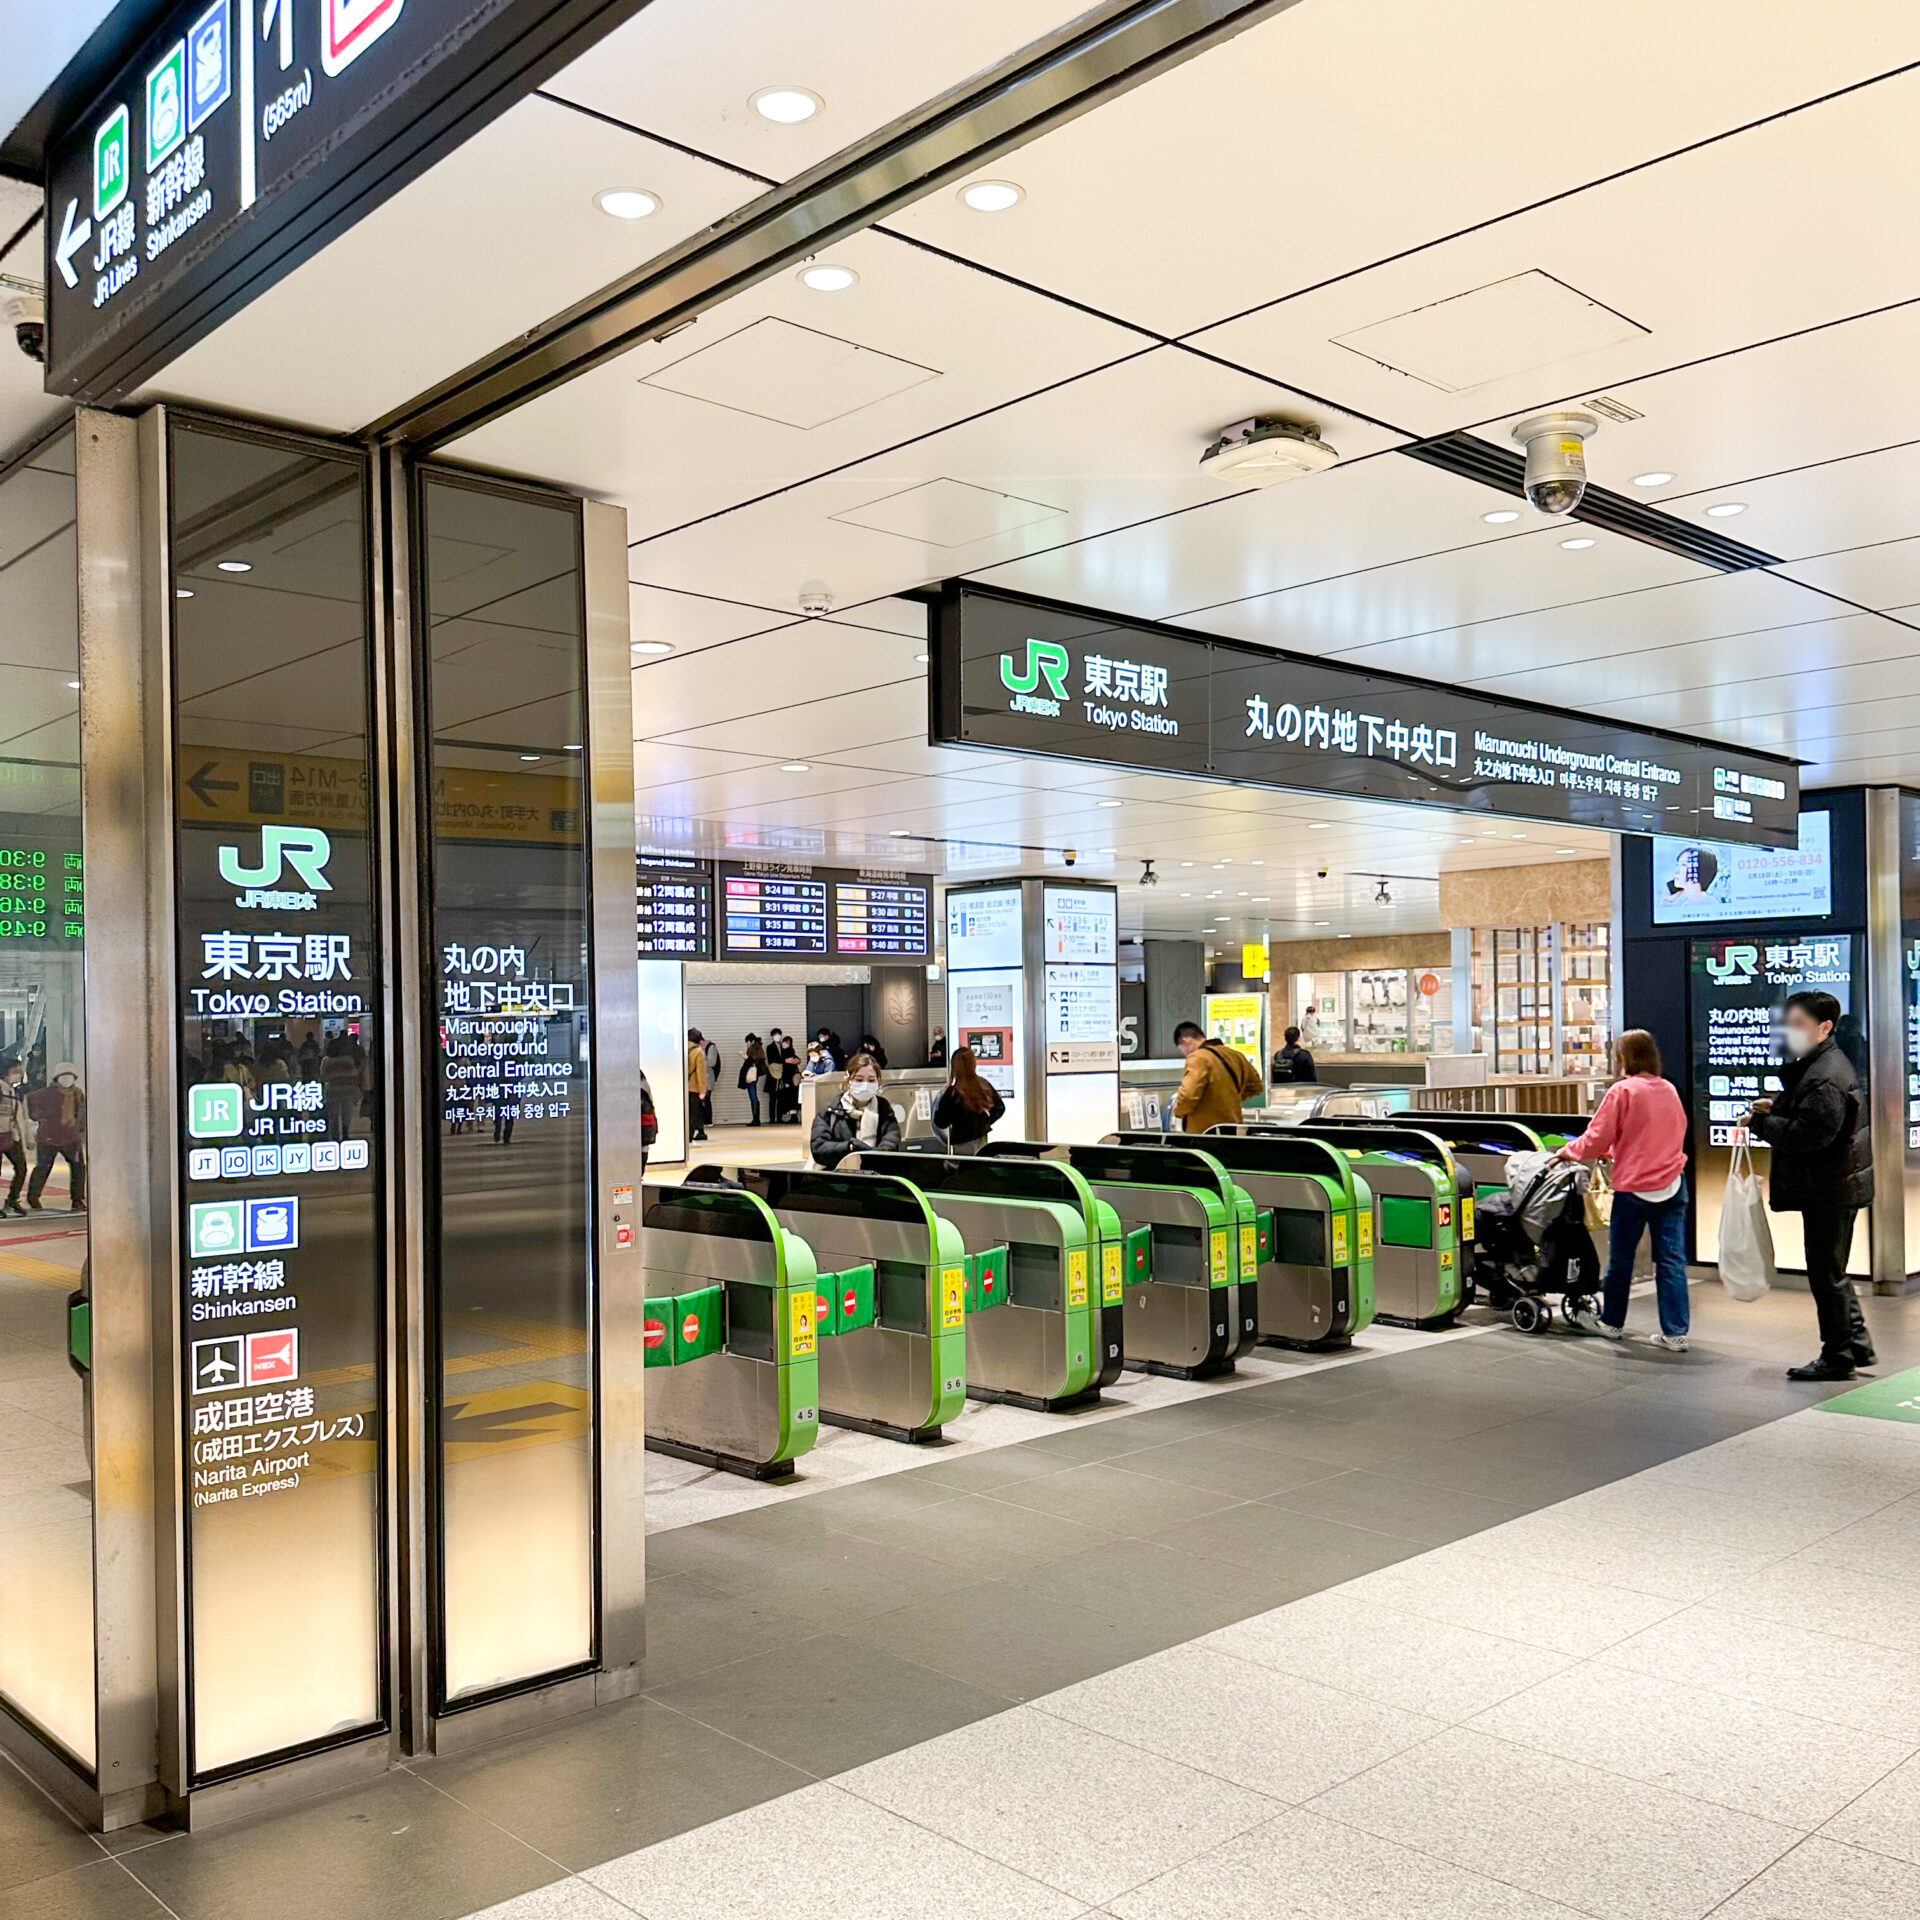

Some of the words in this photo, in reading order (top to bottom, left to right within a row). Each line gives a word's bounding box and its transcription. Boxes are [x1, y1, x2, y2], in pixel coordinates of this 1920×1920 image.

[263, 67, 312, 141] (565m)
[100, 144, 120, 190] JR
[147, 134, 205, 227] 新幹線
[93, 200, 136, 272] JR線
[146, 188, 212, 261] Shinkansen
[93, 275, 110, 309] JR
[110, 255, 138, 296] Lines
[1000, 638, 1070, 701] JR
[1083, 654, 1168, 708] 東京駅
[1010, 695, 1060, 718] JR東日本
[1083, 701, 1128, 731] Tokyo
[1130, 709, 1179, 736] Station
[1245, 694, 1457, 768] 丸の内地下中央口
[1473, 759, 1555, 787] 丸之内地下中央入口
[1474, 730, 1538, 761] Marunouchi
[1539, 742, 1605, 773] Underground
[1606, 752, 1639, 777] Central
[1641, 760, 1681, 785] Entrance
[218, 824, 333, 891] JR
[1738, 854, 1822, 870] 0120-556-834
[235, 890, 317, 910] JR東日本
[200, 930, 353, 982] 東京駅
[443, 944, 526, 976] 丸の内
[1706, 945, 1759, 977] JR
[1764, 943, 1840, 968] 東京駅
[1764, 972, 1803, 987] Tokyo
[1805, 970, 1850, 984] Station
[190, 989, 271, 1016] Tokyo
[278, 988, 362, 1013] Station
[444, 981, 574, 1012] 地下中央口
[445, 1018, 537, 1036] Marunouchi
[1709, 1007, 1770, 1024] 丸の内地
[1709, 1026, 1760, 1035] Marunouchi
[445, 1039, 548, 1060] Underground
[1709, 1036, 1741, 1045] Central
[445, 1061, 500, 1080] Central
[504, 1060, 572, 1078] Entrance
[248, 1081, 324, 1112] JR線
[445, 1083, 568, 1102] 丸之内地下中央入口
[200, 1099, 230, 1122] JR
[248, 1118, 274, 1136] JR
[279, 1115, 326, 1135] Lines
[445, 1105, 496, 1123] 마루노우치
[500, 1104, 521, 1121] 지하
[523, 1103, 545, 1120] 중앙
[548, 1103, 571, 1119] 입구
[197, 1157, 213, 1171] JT
[228, 1155, 246, 1169] JO
[259, 1153, 275, 1167] JK
[288, 1151, 304, 1165] JY
[318, 1150, 334, 1164] JC
[347, 1147, 361, 1161] JU
[1438, 1206, 1450, 1225] IC
[190, 1259, 286, 1299] 新幹線
[191, 1295, 296, 1322] Shinkansen
[193, 1386, 314, 1436] 成田空港
[193, 1413, 365, 1466] (成田エクスプレス)
[194, 1463, 248, 1489] Narita
[251, 1451, 310, 1480] Airport
[194, 1485, 239, 1509] (Narita
[242, 1473, 300, 1500] Express)
